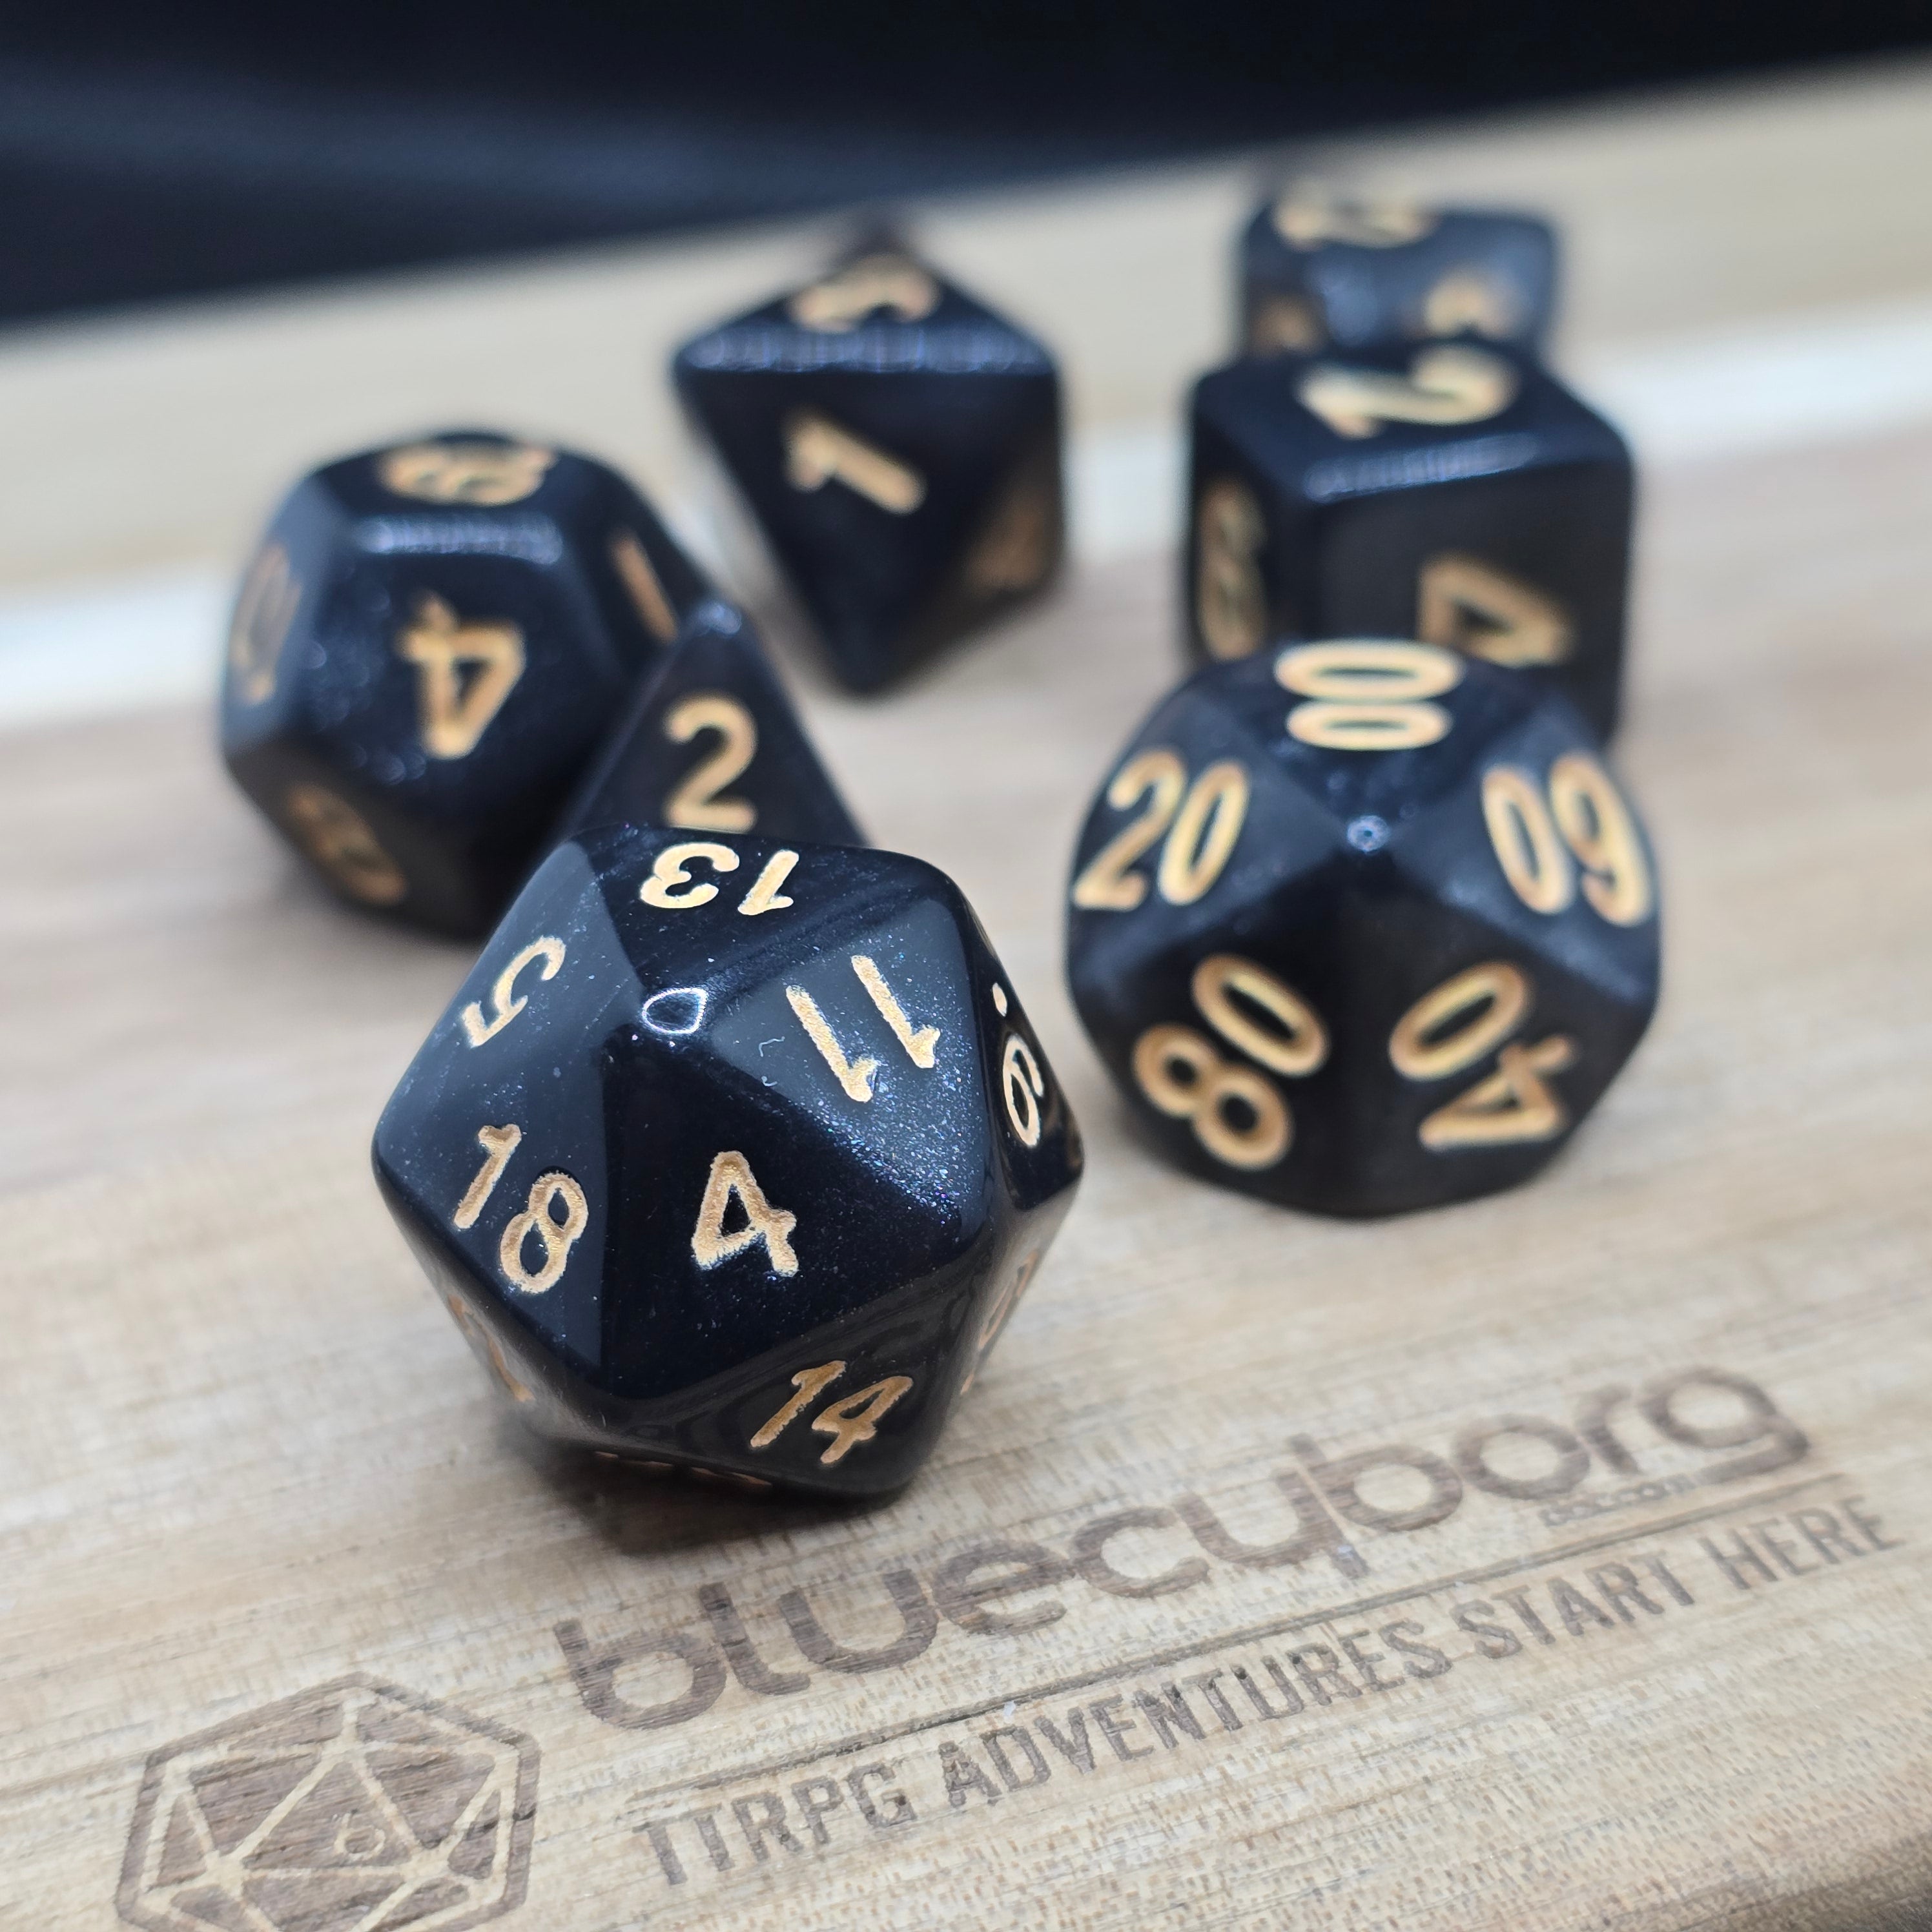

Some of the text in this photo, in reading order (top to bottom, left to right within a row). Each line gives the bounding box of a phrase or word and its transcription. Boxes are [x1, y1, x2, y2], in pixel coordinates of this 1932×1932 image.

[397, 594, 525, 759] 4
[1273, 637, 1465, 751] 00
[665, 694, 761, 832] 2
[1071, 748, 1249, 911] 20
[639, 842, 799, 916] 13
[460, 936, 566, 1047] 5
[786, 955, 940, 1102] 11
[1133, 954, 1328, 1171] 80
[1389, 961, 1576, 1148] 40
[454, 1124, 588, 1293] 18
[692, 1151, 798, 1277] 4
[750, 1359, 913, 1467] 14
[553, 1366, 1811, 1731] bluecyborg
[632, 1762, 917, 1885] TTRPG
[938, 1618, 1453, 1807] ADVENTURES
[1450, 1551, 1696, 1660] START
[1698, 1495, 1907, 1591] HERE
